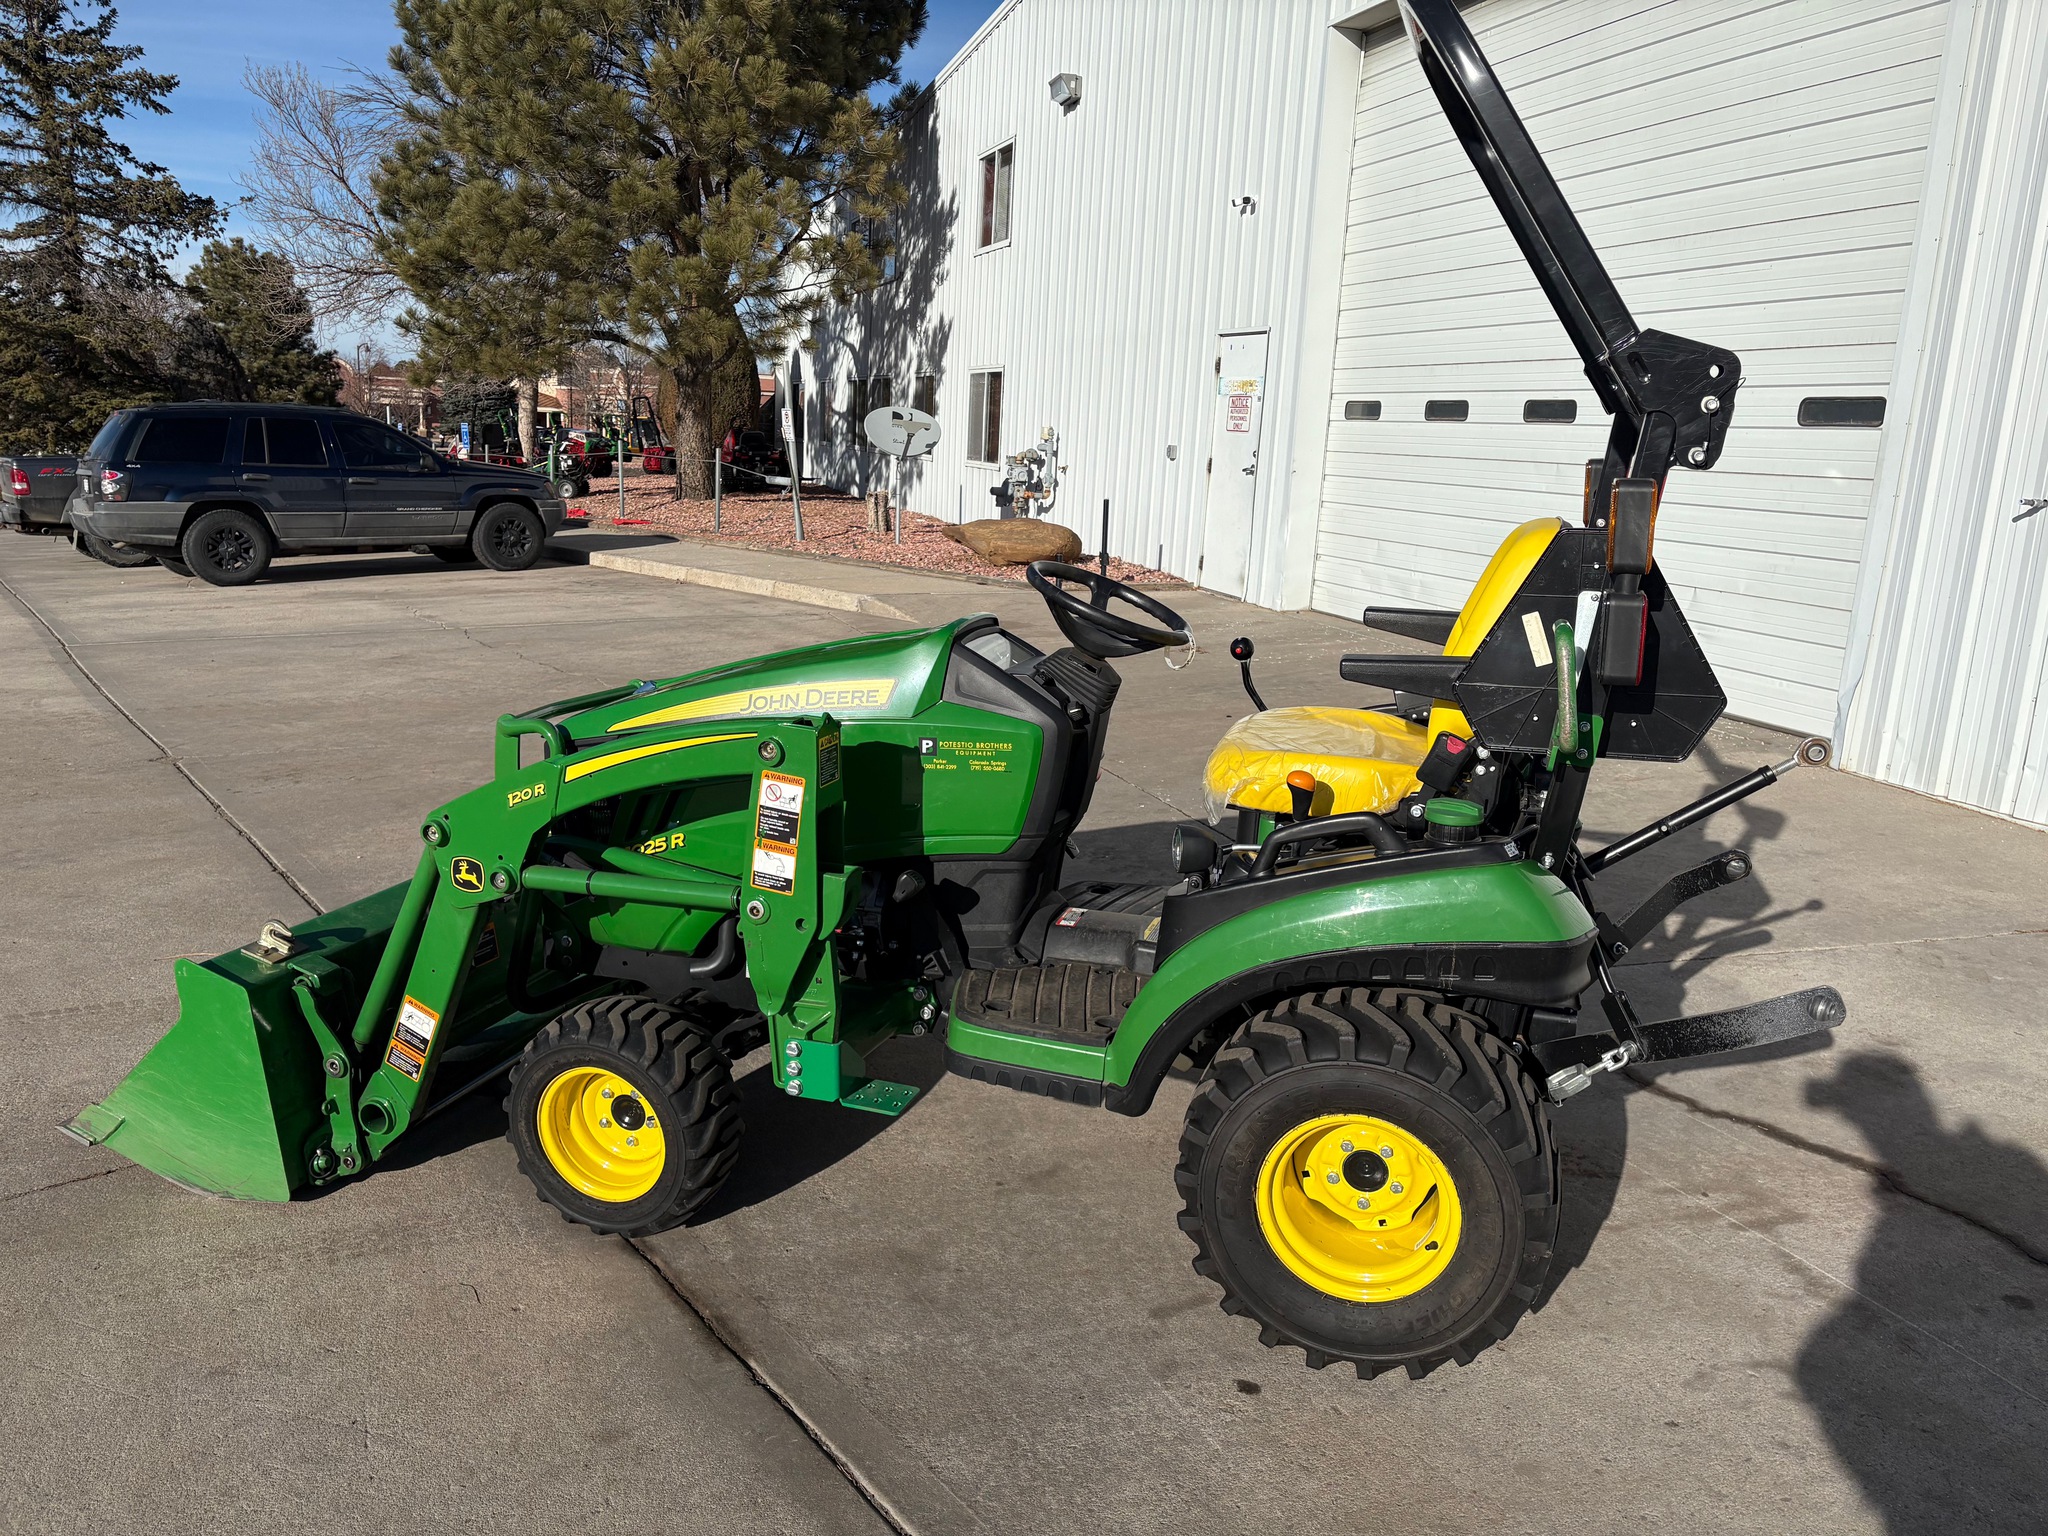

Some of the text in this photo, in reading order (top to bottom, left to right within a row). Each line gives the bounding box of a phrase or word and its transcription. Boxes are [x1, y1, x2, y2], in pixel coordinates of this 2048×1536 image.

[1231, 398, 1249, 407] NOTICE
[1233, 422, 1243, 430] ONLY
[740, 689, 879, 712] JOHN DEERE
[939, 741, 1013, 750] POTESTIO BROTHERS
[770, 773, 803, 785] WARNING
[507, 783, 546, 808] 120 R
[671, 832, 685, 850] R
[762, 842, 795, 855] WARNING
[413, 1003, 435, 1018] WARNING
[400, 1047, 421, 1062] WARNING
